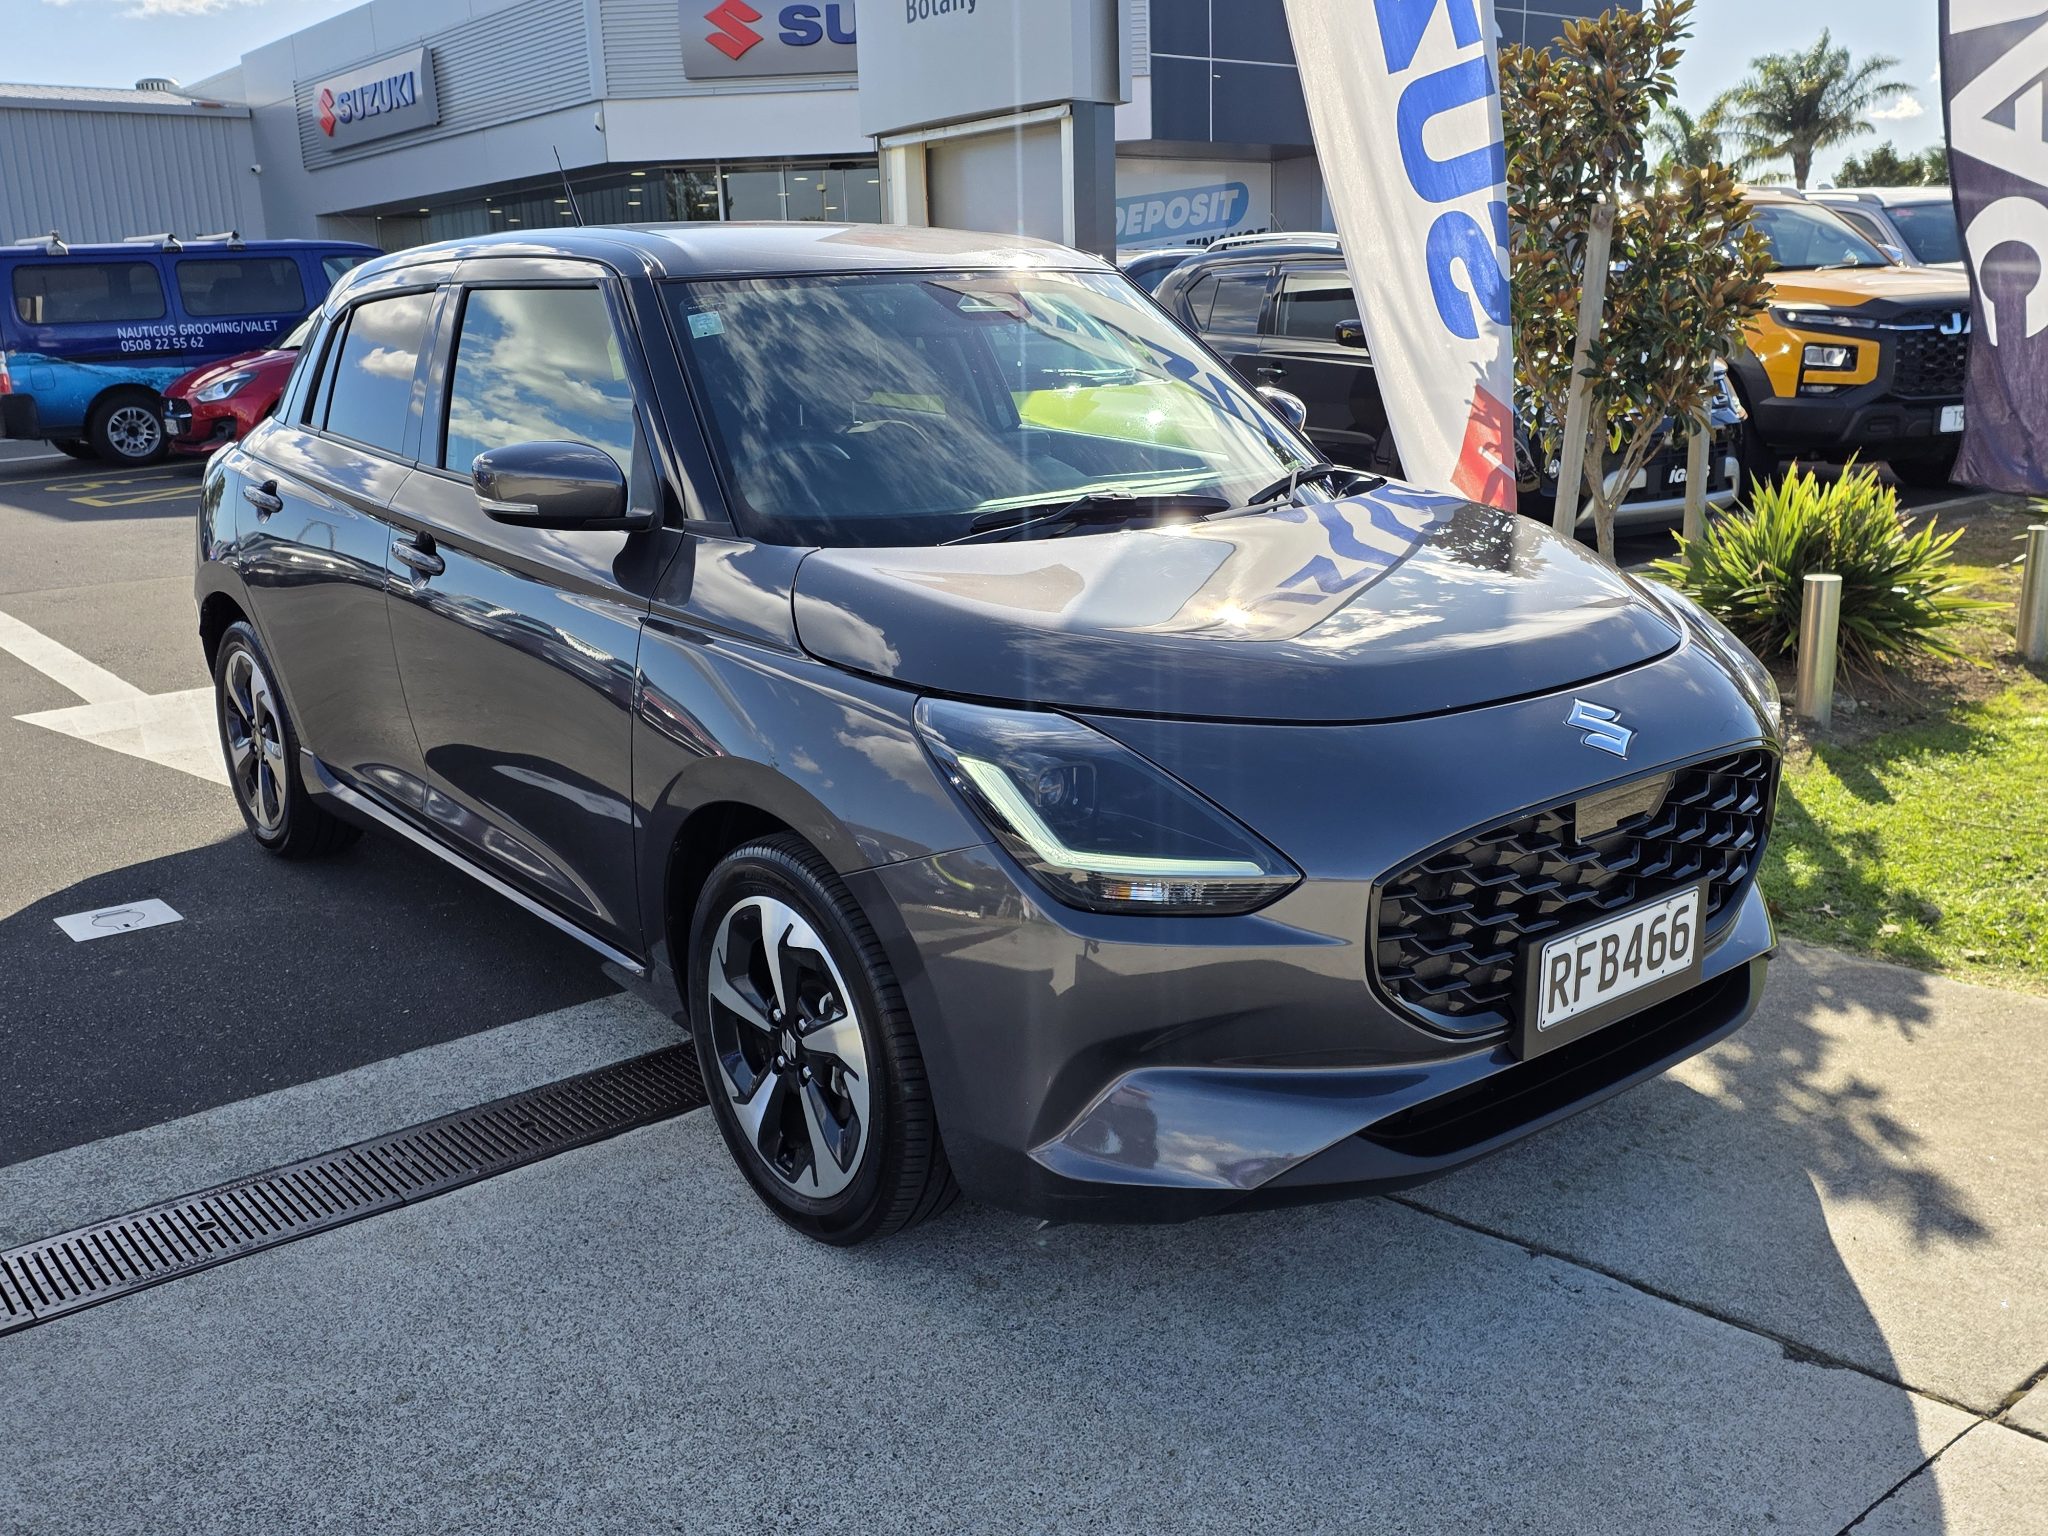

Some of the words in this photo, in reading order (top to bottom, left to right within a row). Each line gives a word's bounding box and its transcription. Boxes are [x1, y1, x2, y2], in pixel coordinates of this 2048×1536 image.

[778, 3, 857, 47] SU
[336, 71, 416, 124] SUZUKI
[117, 324, 177, 339] NAUTICUS
[179, 320, 278, 335] GROOMING/VALET
[121, 339, 151, 352] 0508
[155, 338, 170, 350] 22
[173, 337, 188, 349] 55
[190, 336, 205, 348] 62
[1548, 905, 1690, 1013] RFB466
